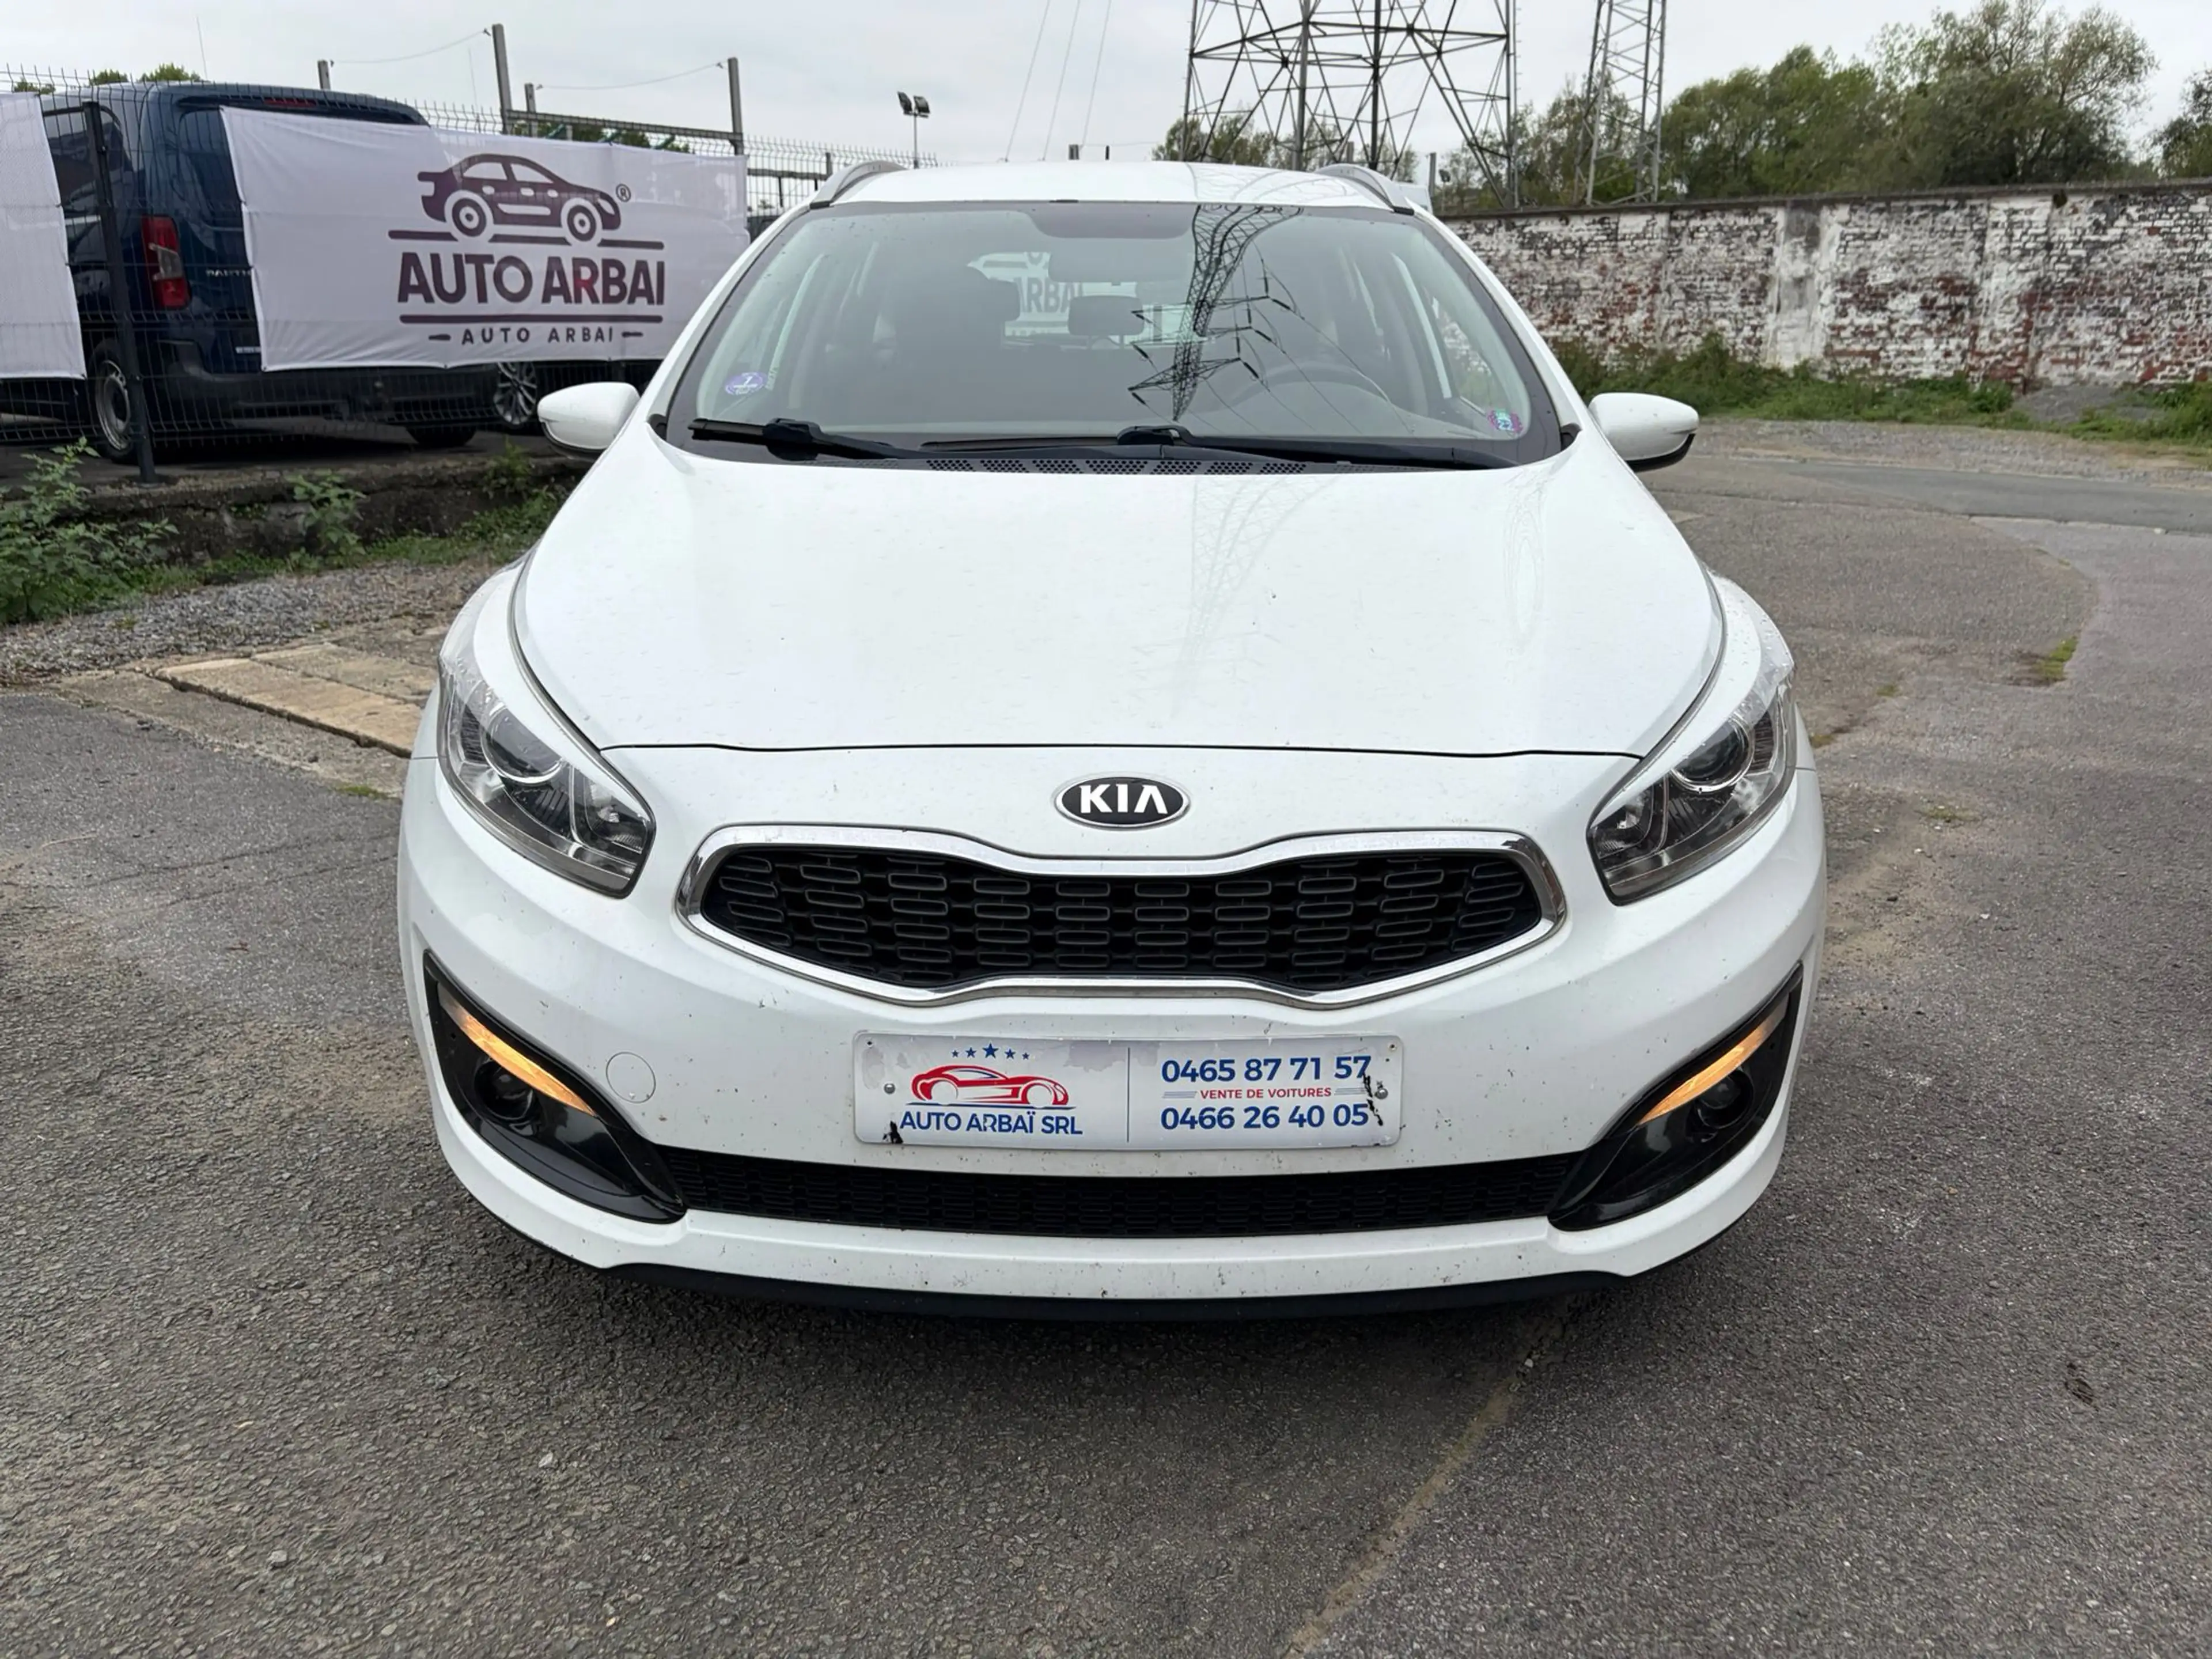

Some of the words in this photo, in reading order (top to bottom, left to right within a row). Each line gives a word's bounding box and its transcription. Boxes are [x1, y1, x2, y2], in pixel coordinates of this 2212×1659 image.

[397, 252, 533, 304] AUTO
[541, 256, 665, 305] ARBAI
[461, 327, 530, 346] AUTO
[548, 325, 613, 343] ARBAI
[1079, 784, 1169, 815] KIA
[1161, 1059, 1236, 1082] 0465
[1244, 1058, 1282, 1081] 87
[1289, 1057, 1321, 1080] 71
[1334, 1055, 1372, 1079] 57
[1200, 1089, 1243, 1099] VENTE
[1246, 1089, 1264, 1099] DE
[1267, 1087, 1332, 1098] VOITURES
[899, 1111, 962, 1131] AUTO
[965, 1111, 1036, 1134] ARBAÏ
[1041, 1115, 1083, 1135] SRL
[1161, 1107, 1236, 1130] 0466
[1243, 1105, 1281, 1129] 26
[1288, 1104, 1325, 1128] 40
[1333, 1103, 1369, 1127] 05
